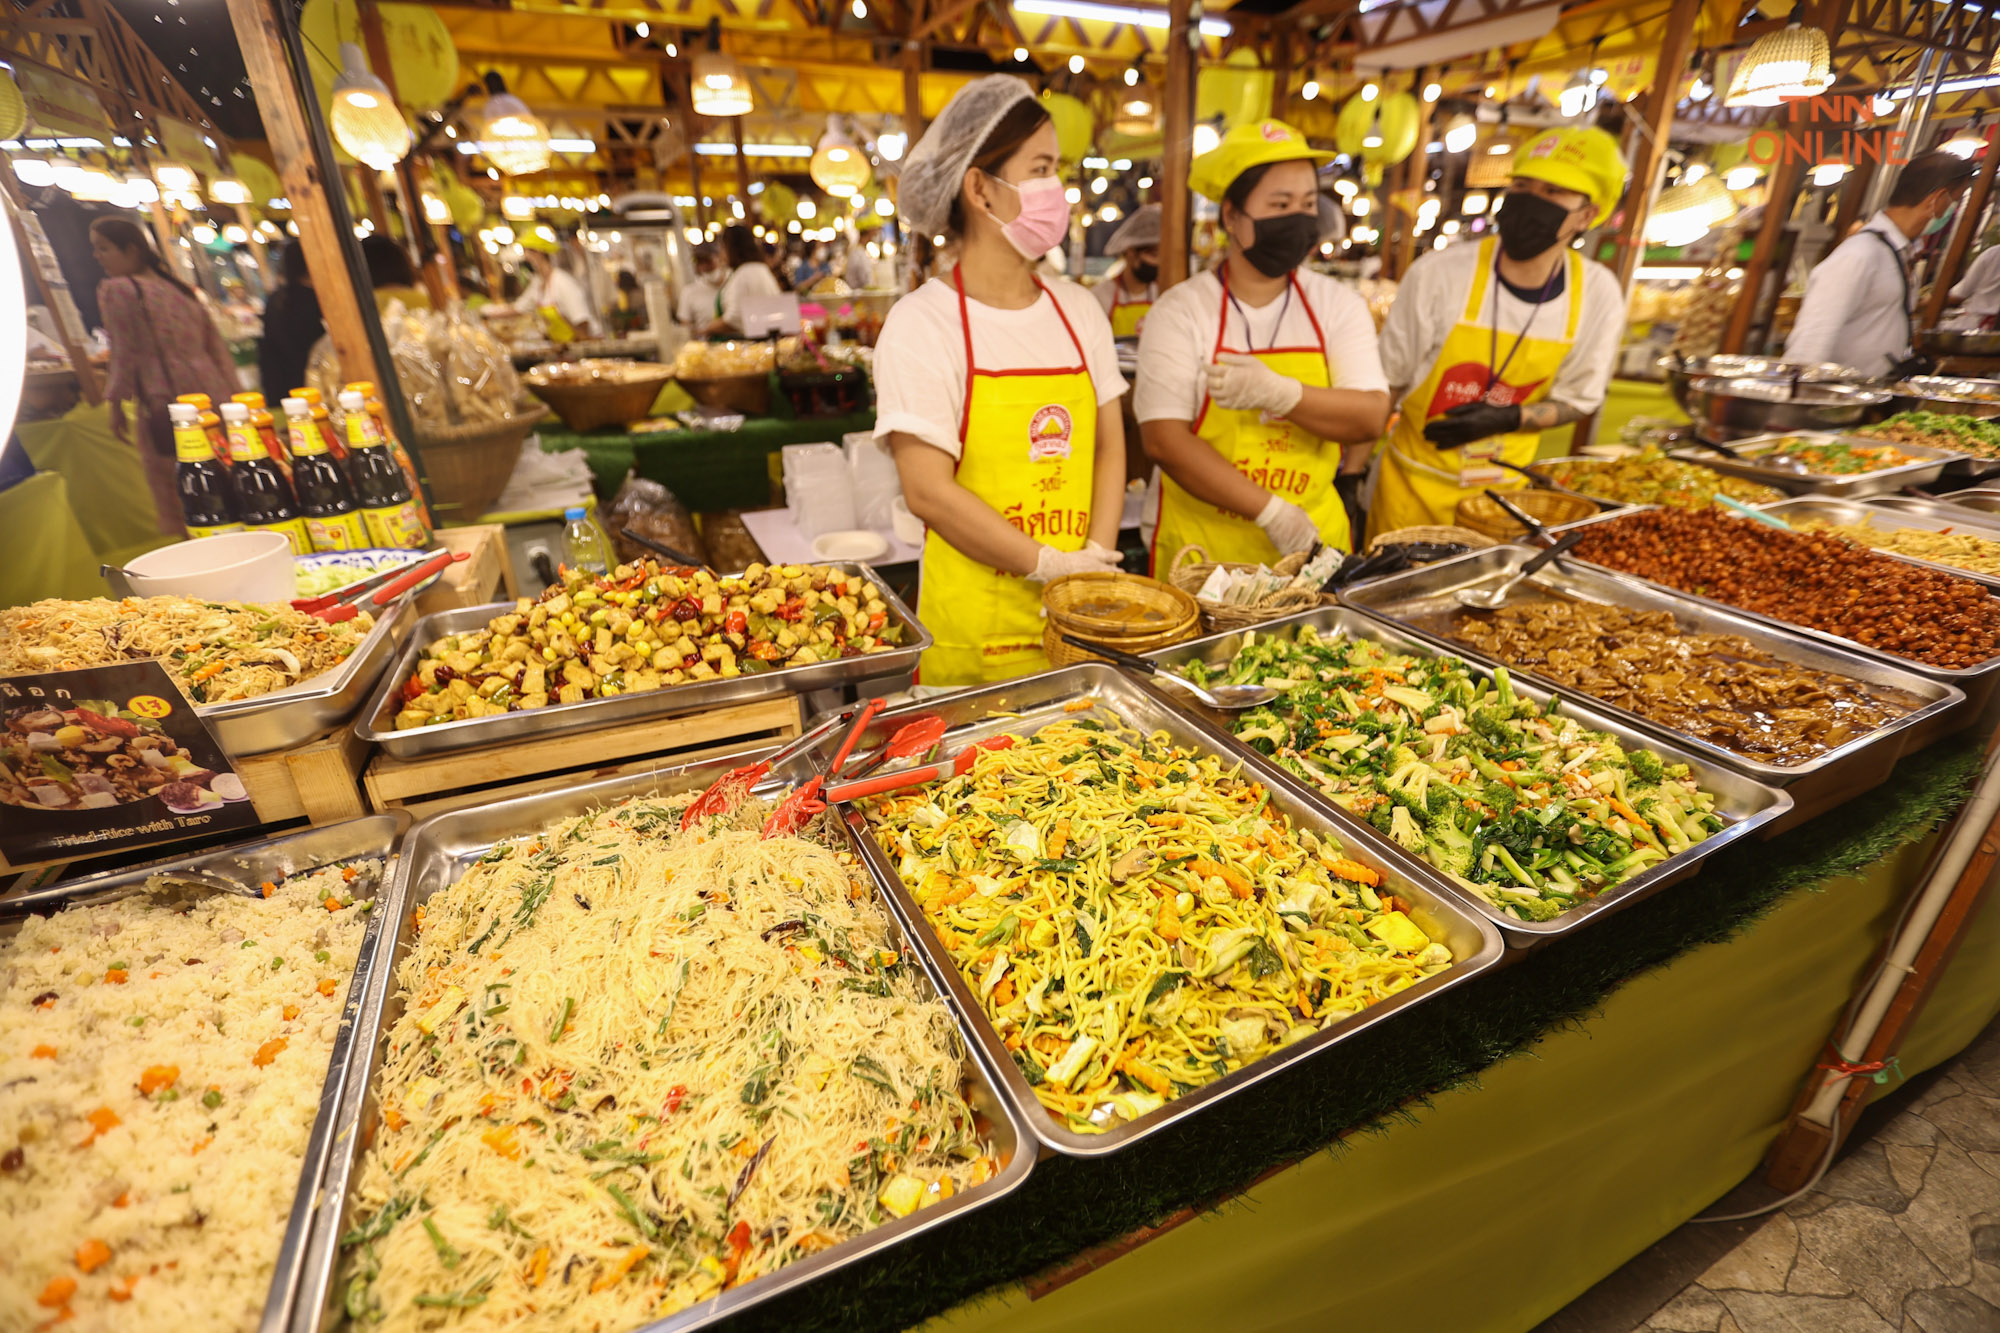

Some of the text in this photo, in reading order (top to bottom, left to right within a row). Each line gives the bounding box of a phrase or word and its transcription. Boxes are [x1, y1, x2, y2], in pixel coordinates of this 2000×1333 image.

[54, 815, 212, 848] Fried Rice with Taro
